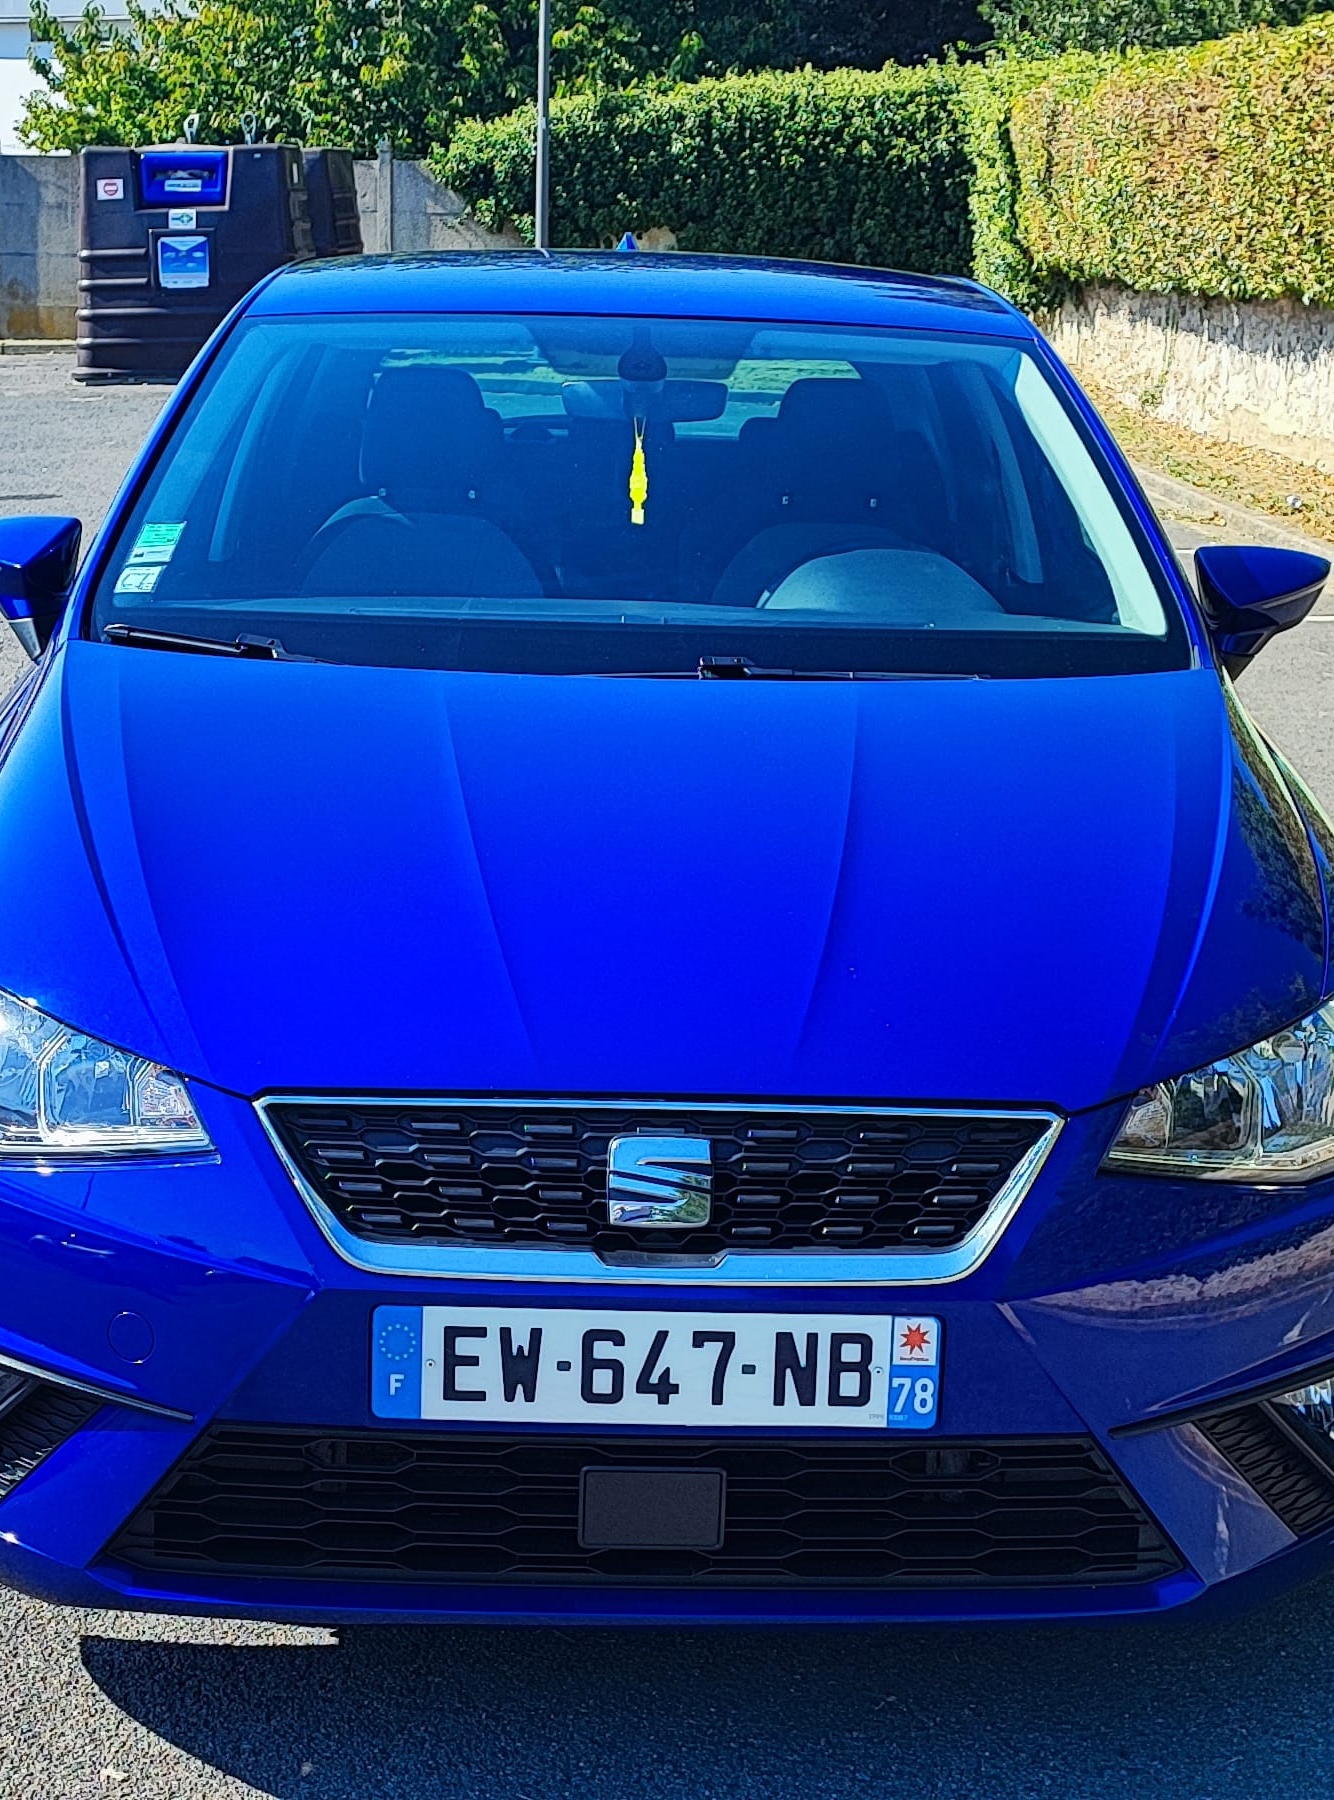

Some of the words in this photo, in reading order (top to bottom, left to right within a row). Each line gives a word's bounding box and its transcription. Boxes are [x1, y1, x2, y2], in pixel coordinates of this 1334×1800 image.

[389, 1373, 405, 1395] F
[443, 1325, 873, 1407] EW-647-NB
[891, 1377, 934, 1414] 78
